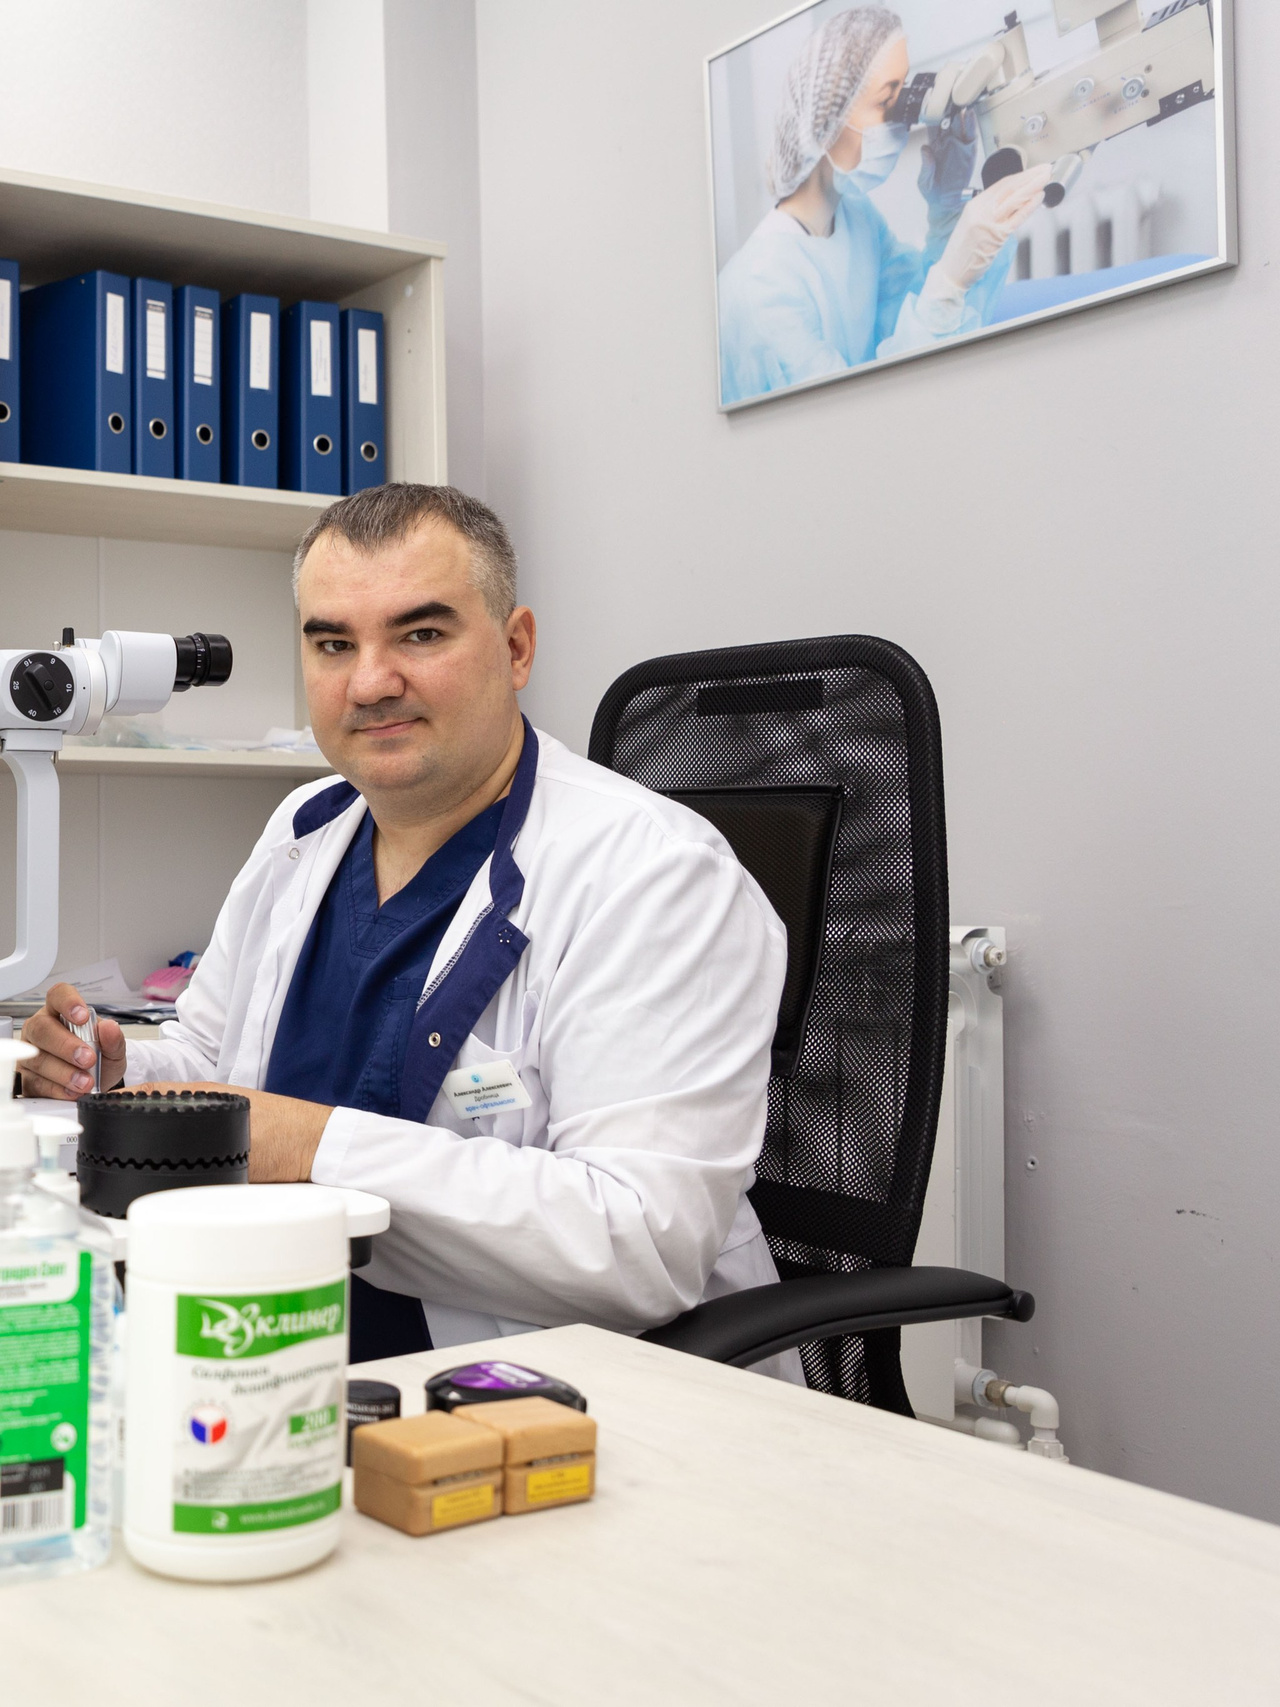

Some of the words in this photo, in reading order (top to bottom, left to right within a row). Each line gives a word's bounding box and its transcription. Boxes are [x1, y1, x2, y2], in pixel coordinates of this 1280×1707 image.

[13, 681, 19, 690] 25
[66, 684, 72, 692] 10
[28, 709, 37, 717] 40
[53, 707, 62, 716] 16
[454, 1088, 481, 1097] Александр
[482, 1082, 512, 1092] Алексеевич
